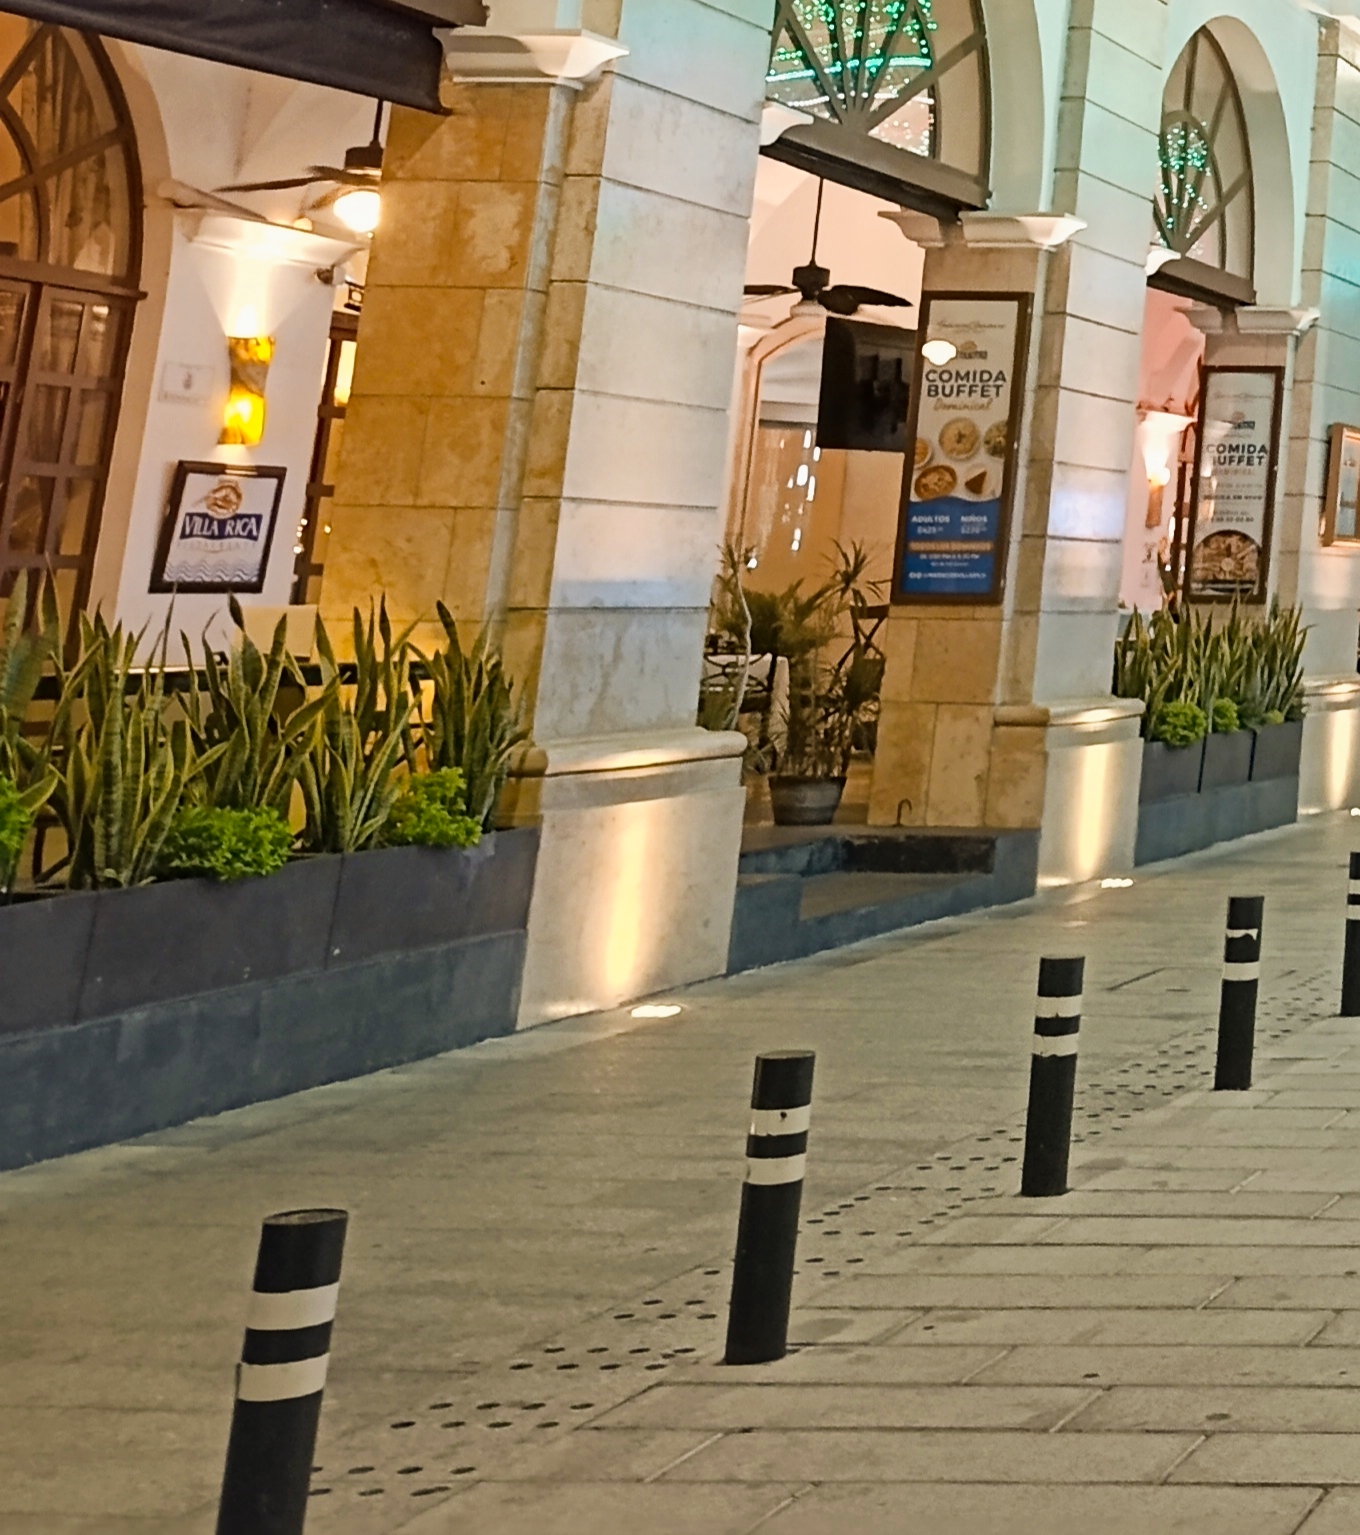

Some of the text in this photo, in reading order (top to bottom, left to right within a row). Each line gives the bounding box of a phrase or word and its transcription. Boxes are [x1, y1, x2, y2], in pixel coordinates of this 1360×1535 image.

[925, 369, 1007, 383] COMIDA
[927, 384, 1004, 398] BUFFET
[1205, 443, 1269, 455] COMIDA
[184, 515, 258, 536] VILLA RICA
